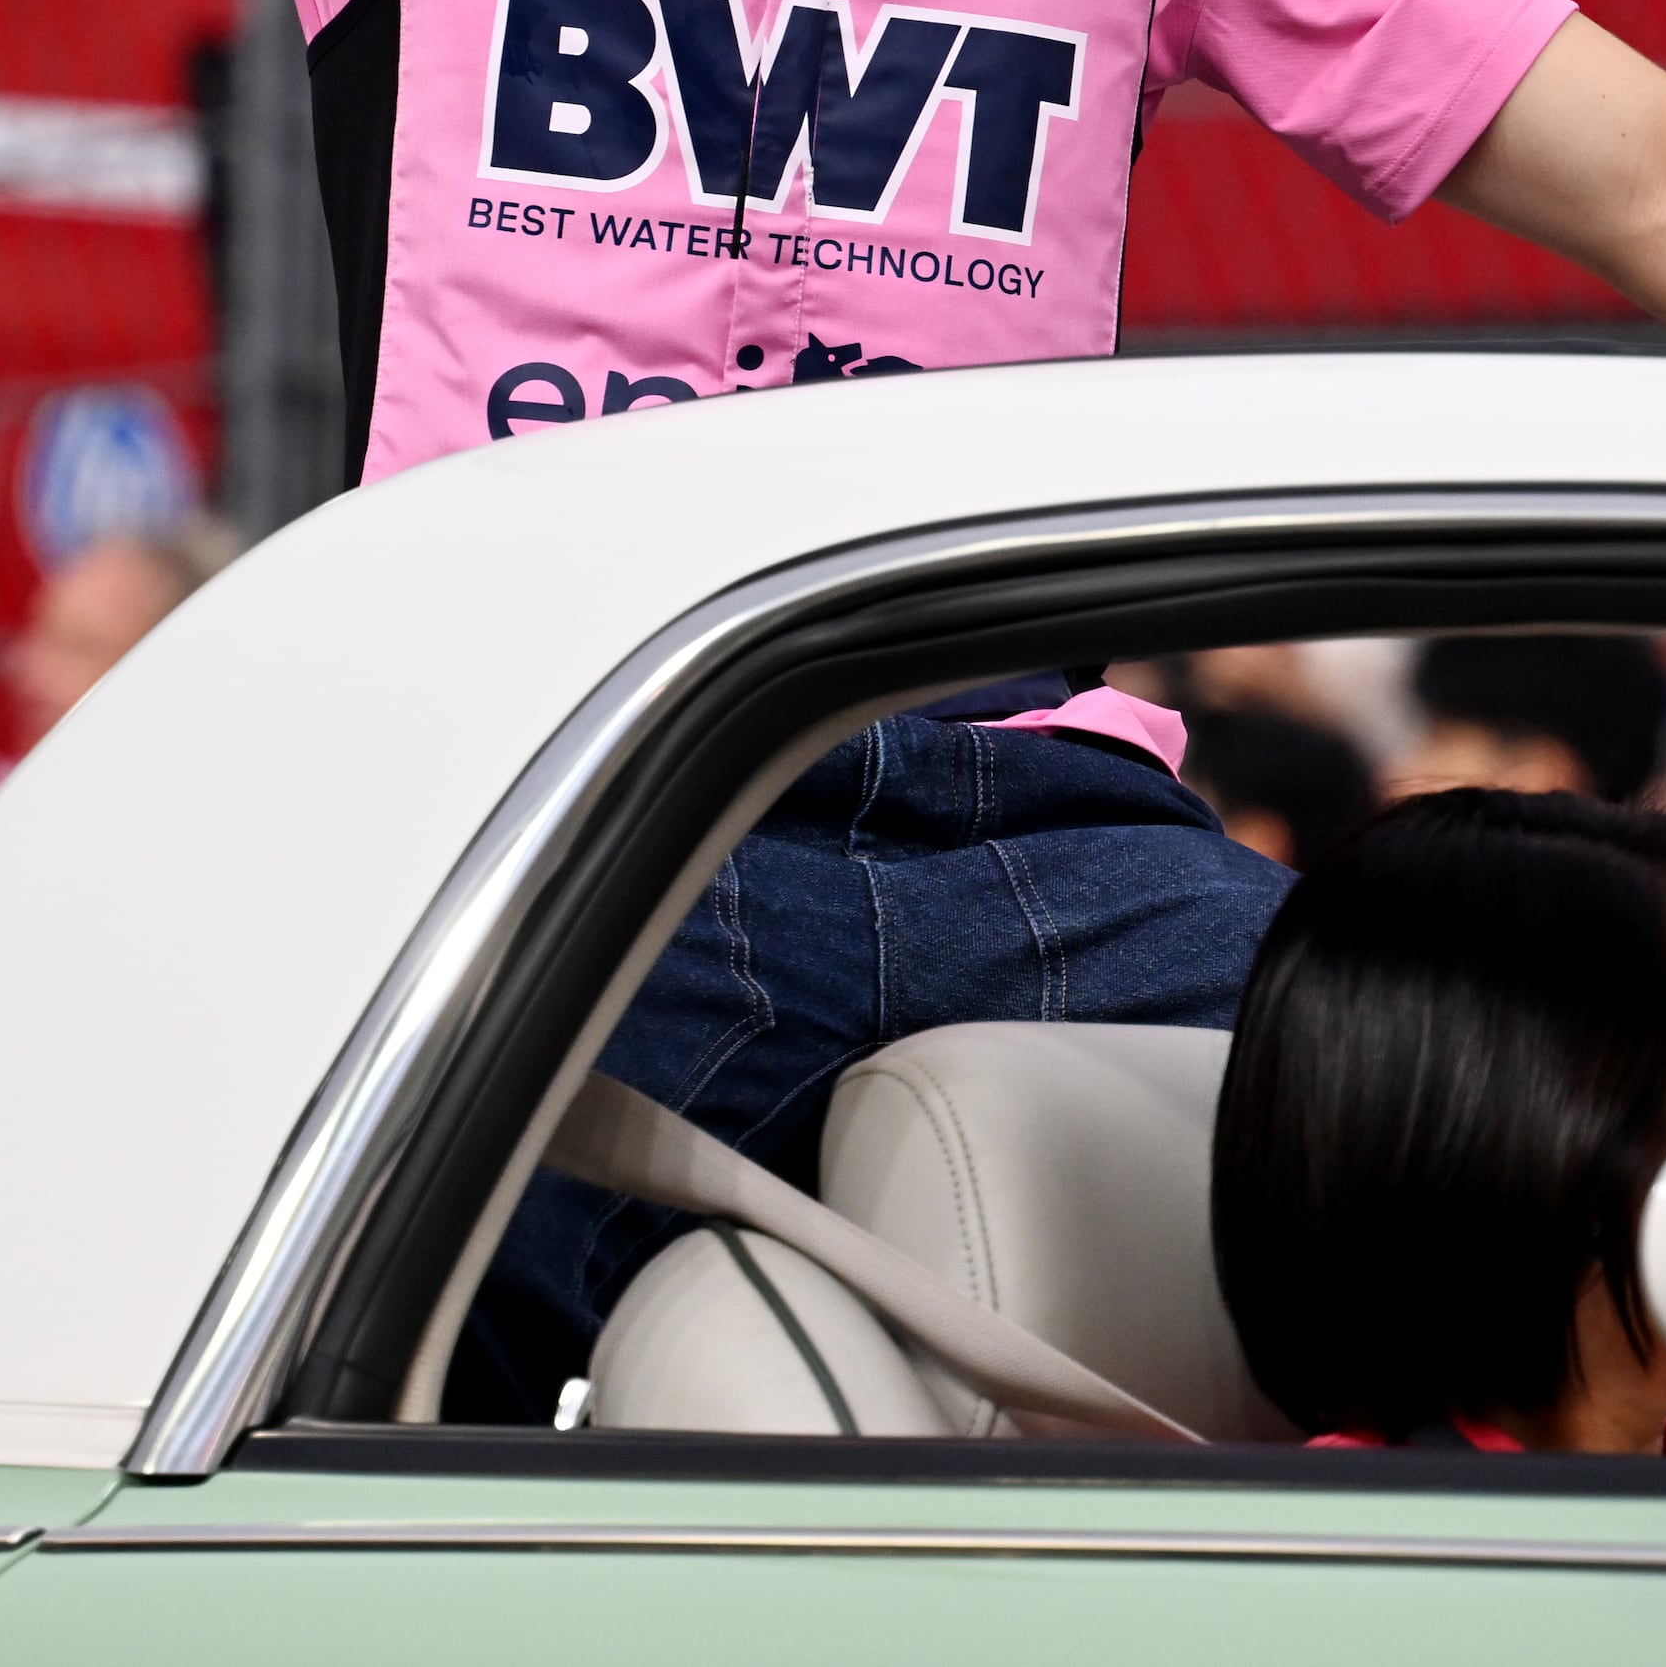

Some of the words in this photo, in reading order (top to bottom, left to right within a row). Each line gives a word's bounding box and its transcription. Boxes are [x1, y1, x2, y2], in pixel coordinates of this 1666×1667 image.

[468, 197, 575, 239] BEST
[590, 212, 752, 260] WATER
[768, 232, 1044, 299] TECHNOLOGY
